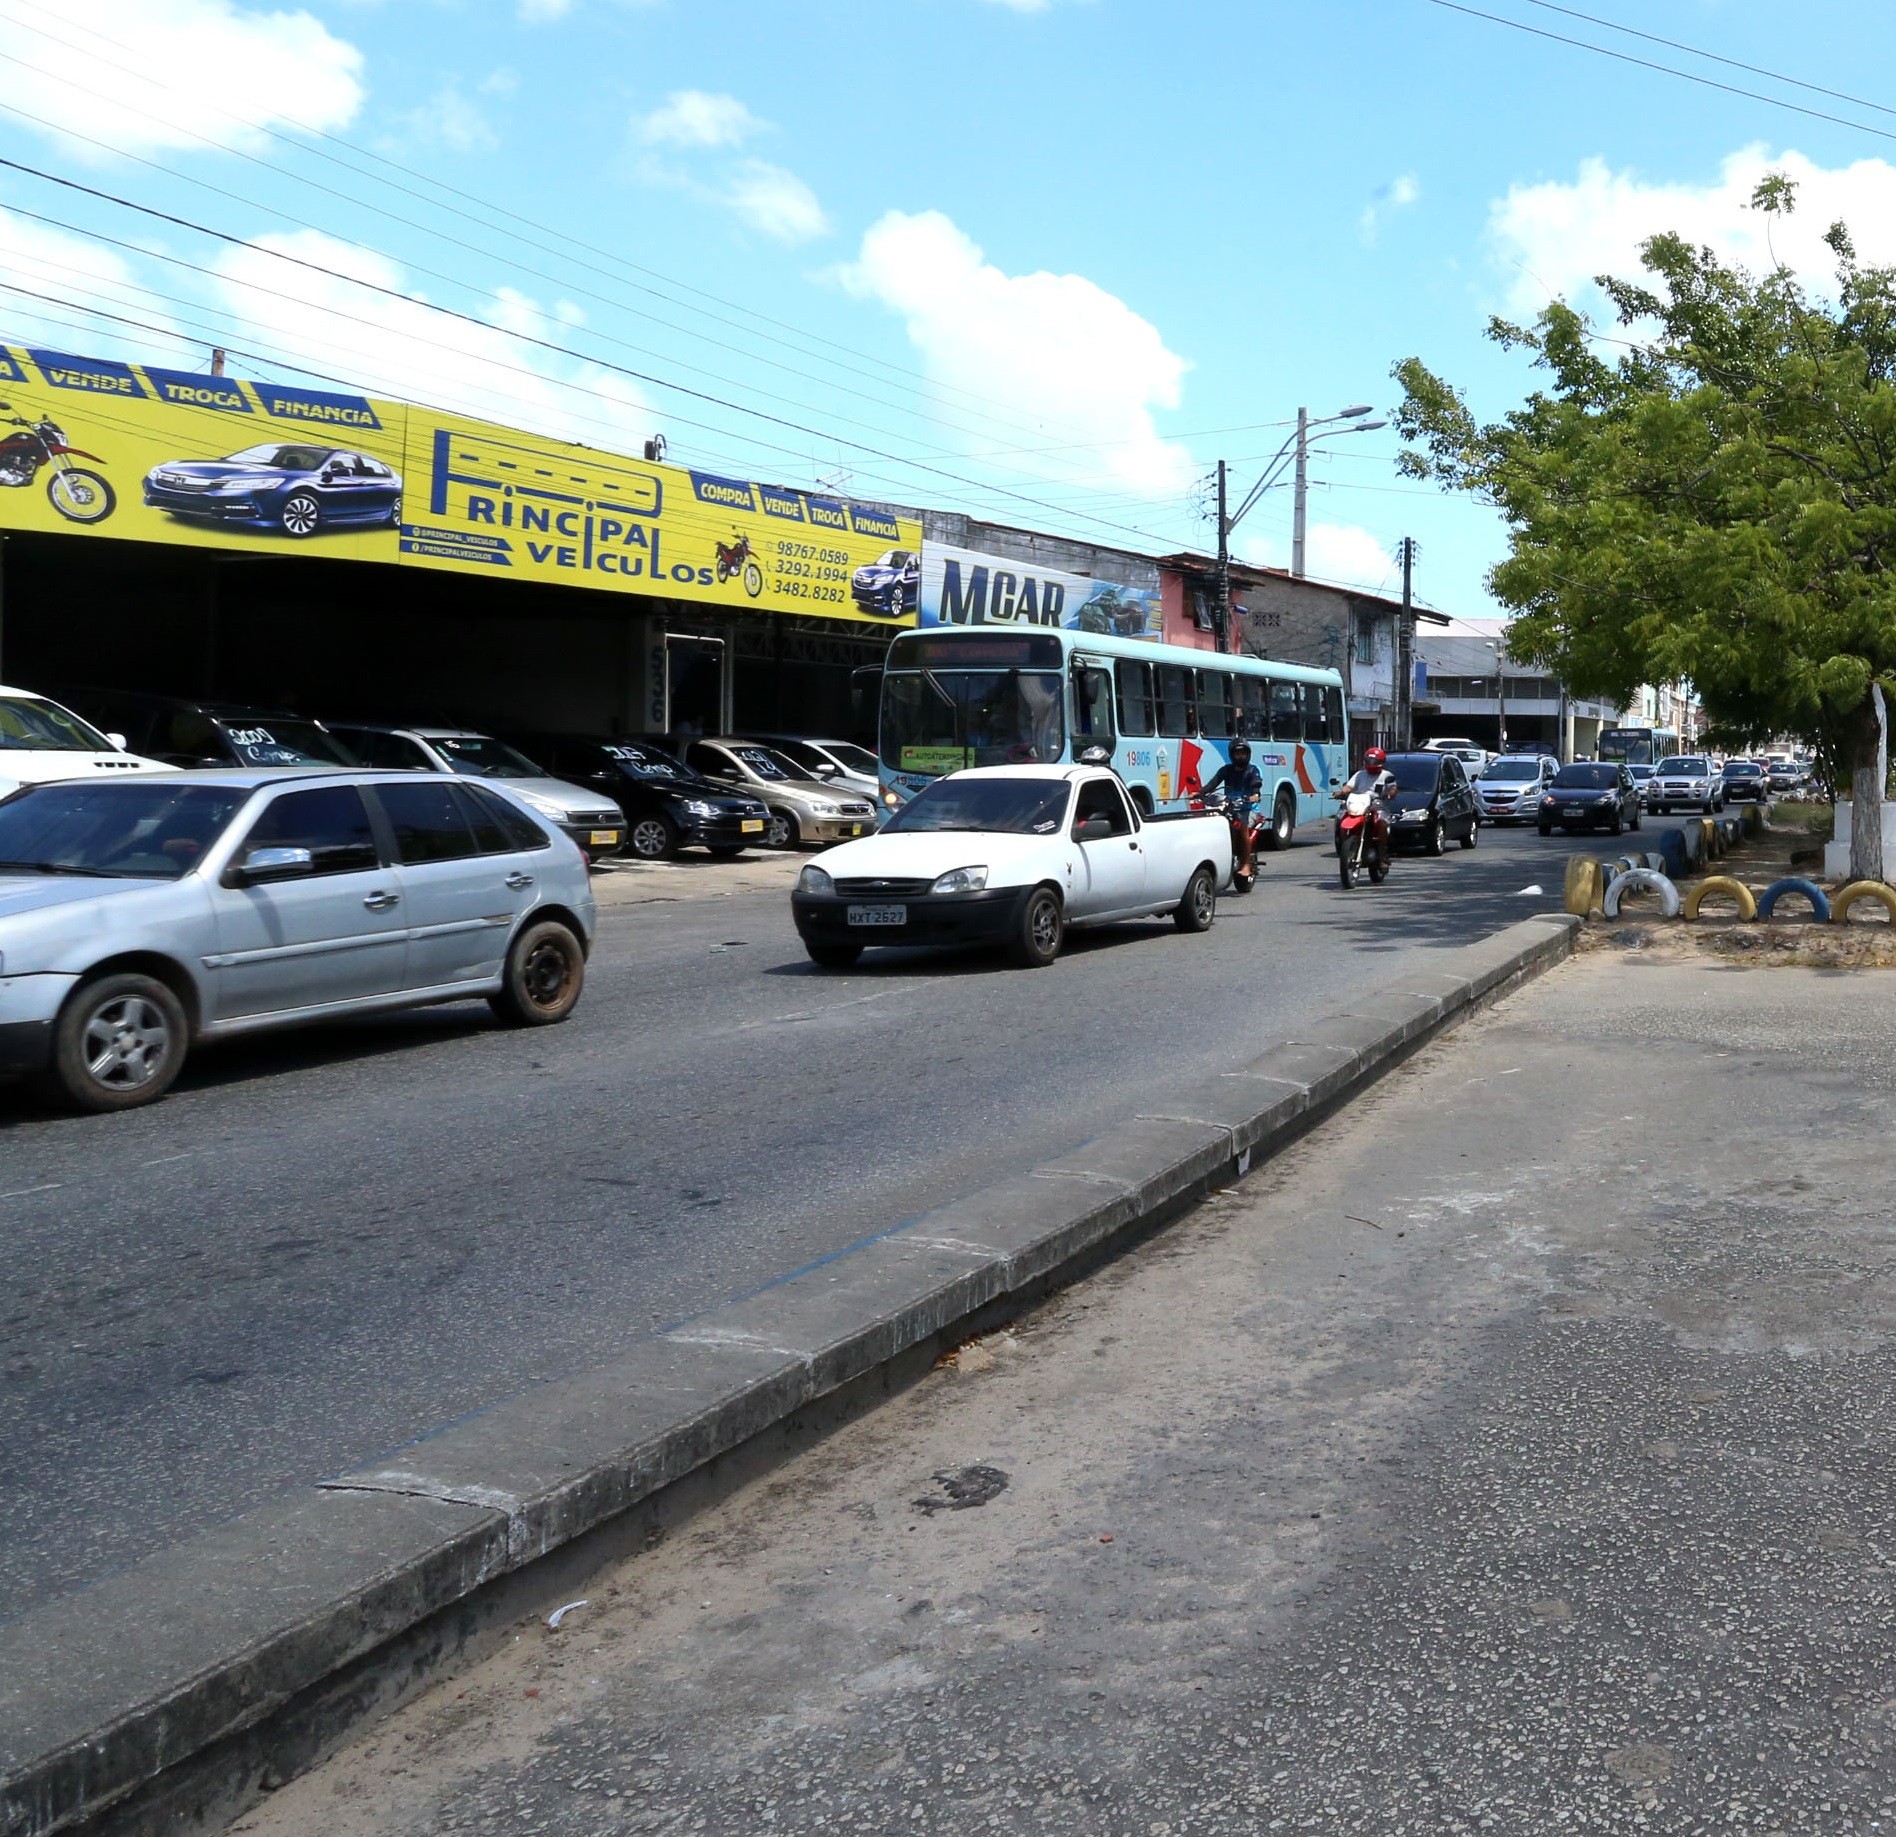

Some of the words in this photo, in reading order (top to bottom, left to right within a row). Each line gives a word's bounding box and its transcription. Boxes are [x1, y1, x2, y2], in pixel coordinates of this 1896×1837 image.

[50, 368, 133, 393] VENDE
[165, 384, 243, 409] TROCA
[273, 400, 374, 426] FINANCIA
[701, 482, 750, 507] COMPRA
[765, 496, 800, 517] VENDE
[812, 507, 844, 526] TROCA
[855, 516, 897, 538] FINANCIA
[777, 540, 849, 566] 98767.0589
[775, 559, 848, 583] 3292.1994
[773, 579, 846, 604] 3482.8282
[1127, 751, 1150, 766] 19806
